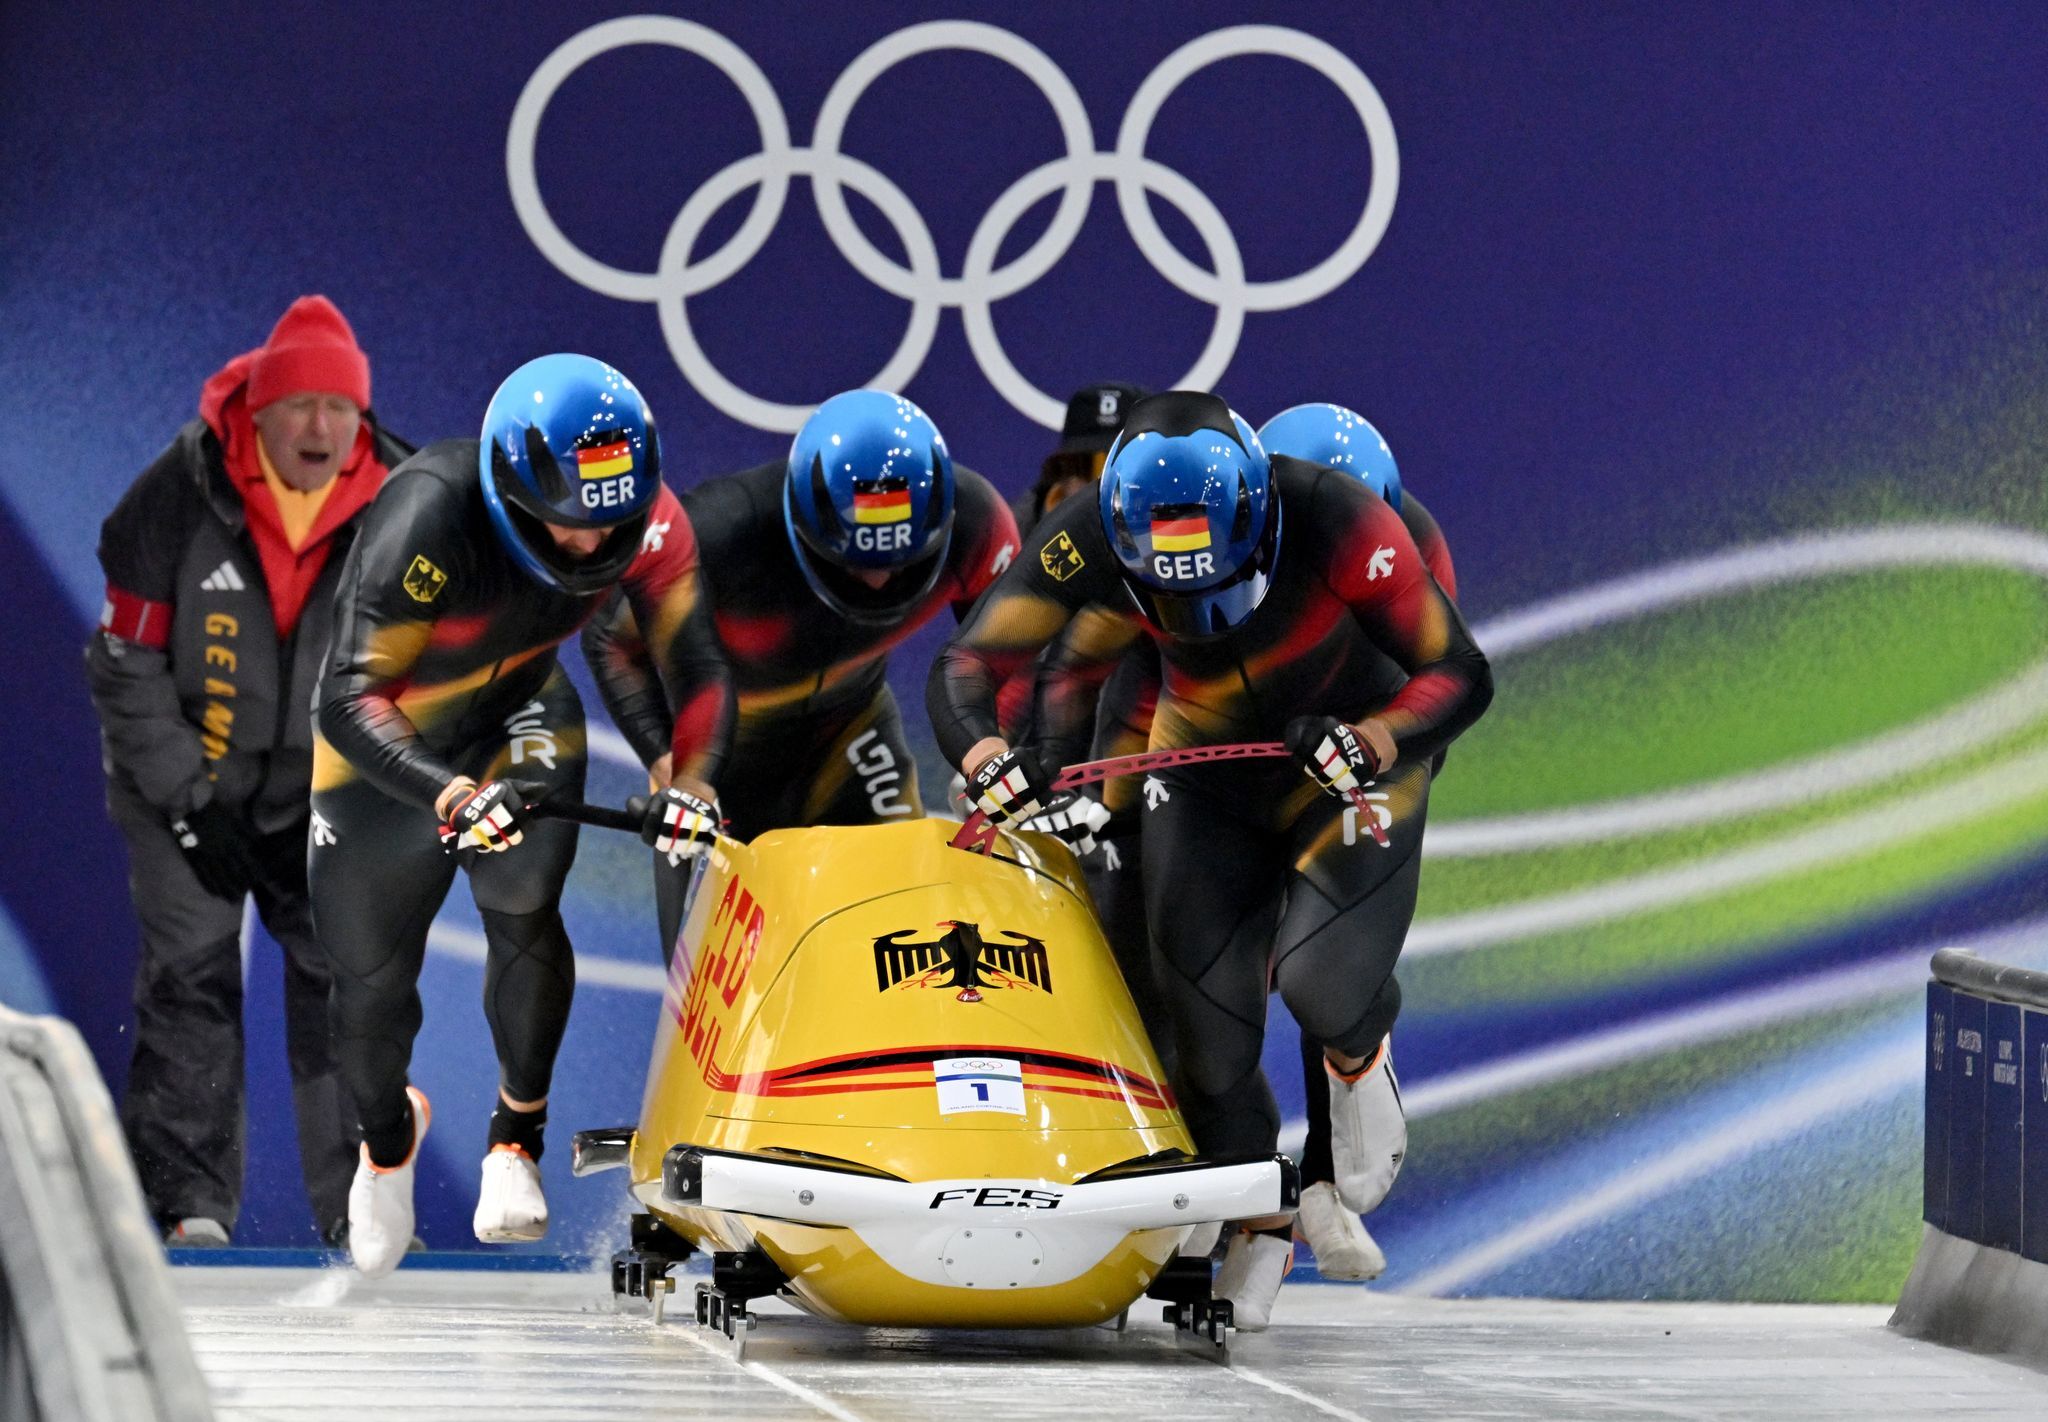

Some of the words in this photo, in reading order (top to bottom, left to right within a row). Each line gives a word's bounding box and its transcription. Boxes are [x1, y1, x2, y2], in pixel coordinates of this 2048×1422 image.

[581, 475, 636, 508] GER
[855, 523, 913, 551] GER
[1153, 552, 1216, 580] GER
[1334, 723, 1365, 768] SEIZ
[976, 749, 1015, 787] SEIZ
[464, 782, 502, 822] SEIZ
[667, 786, 712, 816] SEIZ
[970, 1083, 989, 1101] 1
[929, 1187, 1064, 1210] FES
